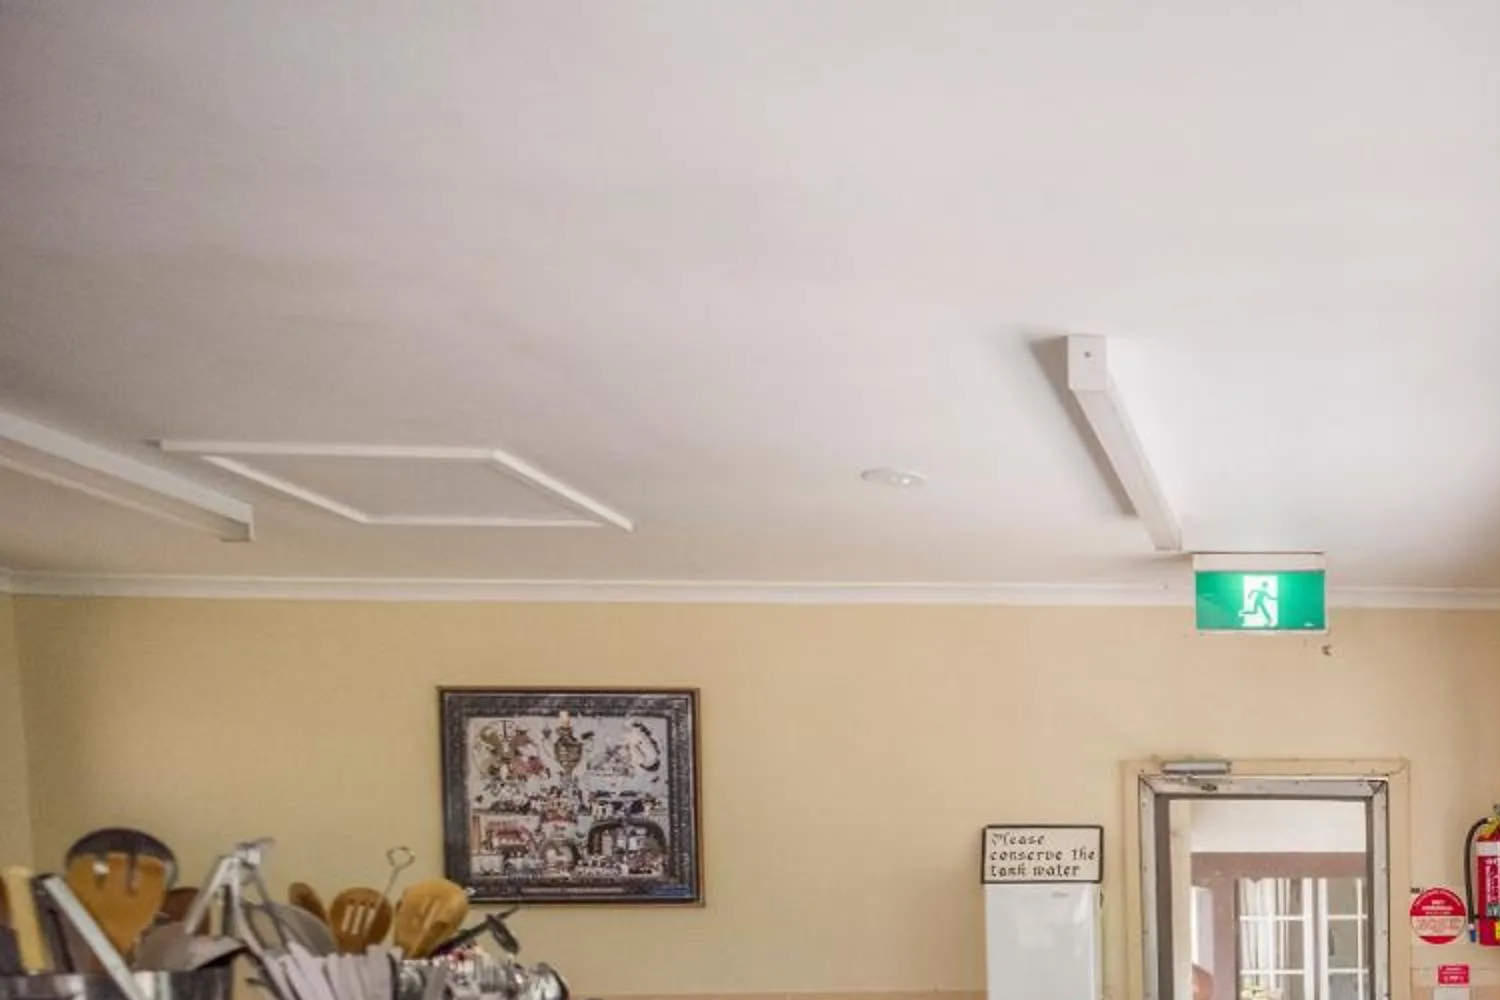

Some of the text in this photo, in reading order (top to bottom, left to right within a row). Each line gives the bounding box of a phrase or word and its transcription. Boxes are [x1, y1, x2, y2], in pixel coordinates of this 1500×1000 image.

[991, 832, 1045, 846] Please
[990, 847, 1096, 861] conserve the
[1032, 865, 1081, 877] water
